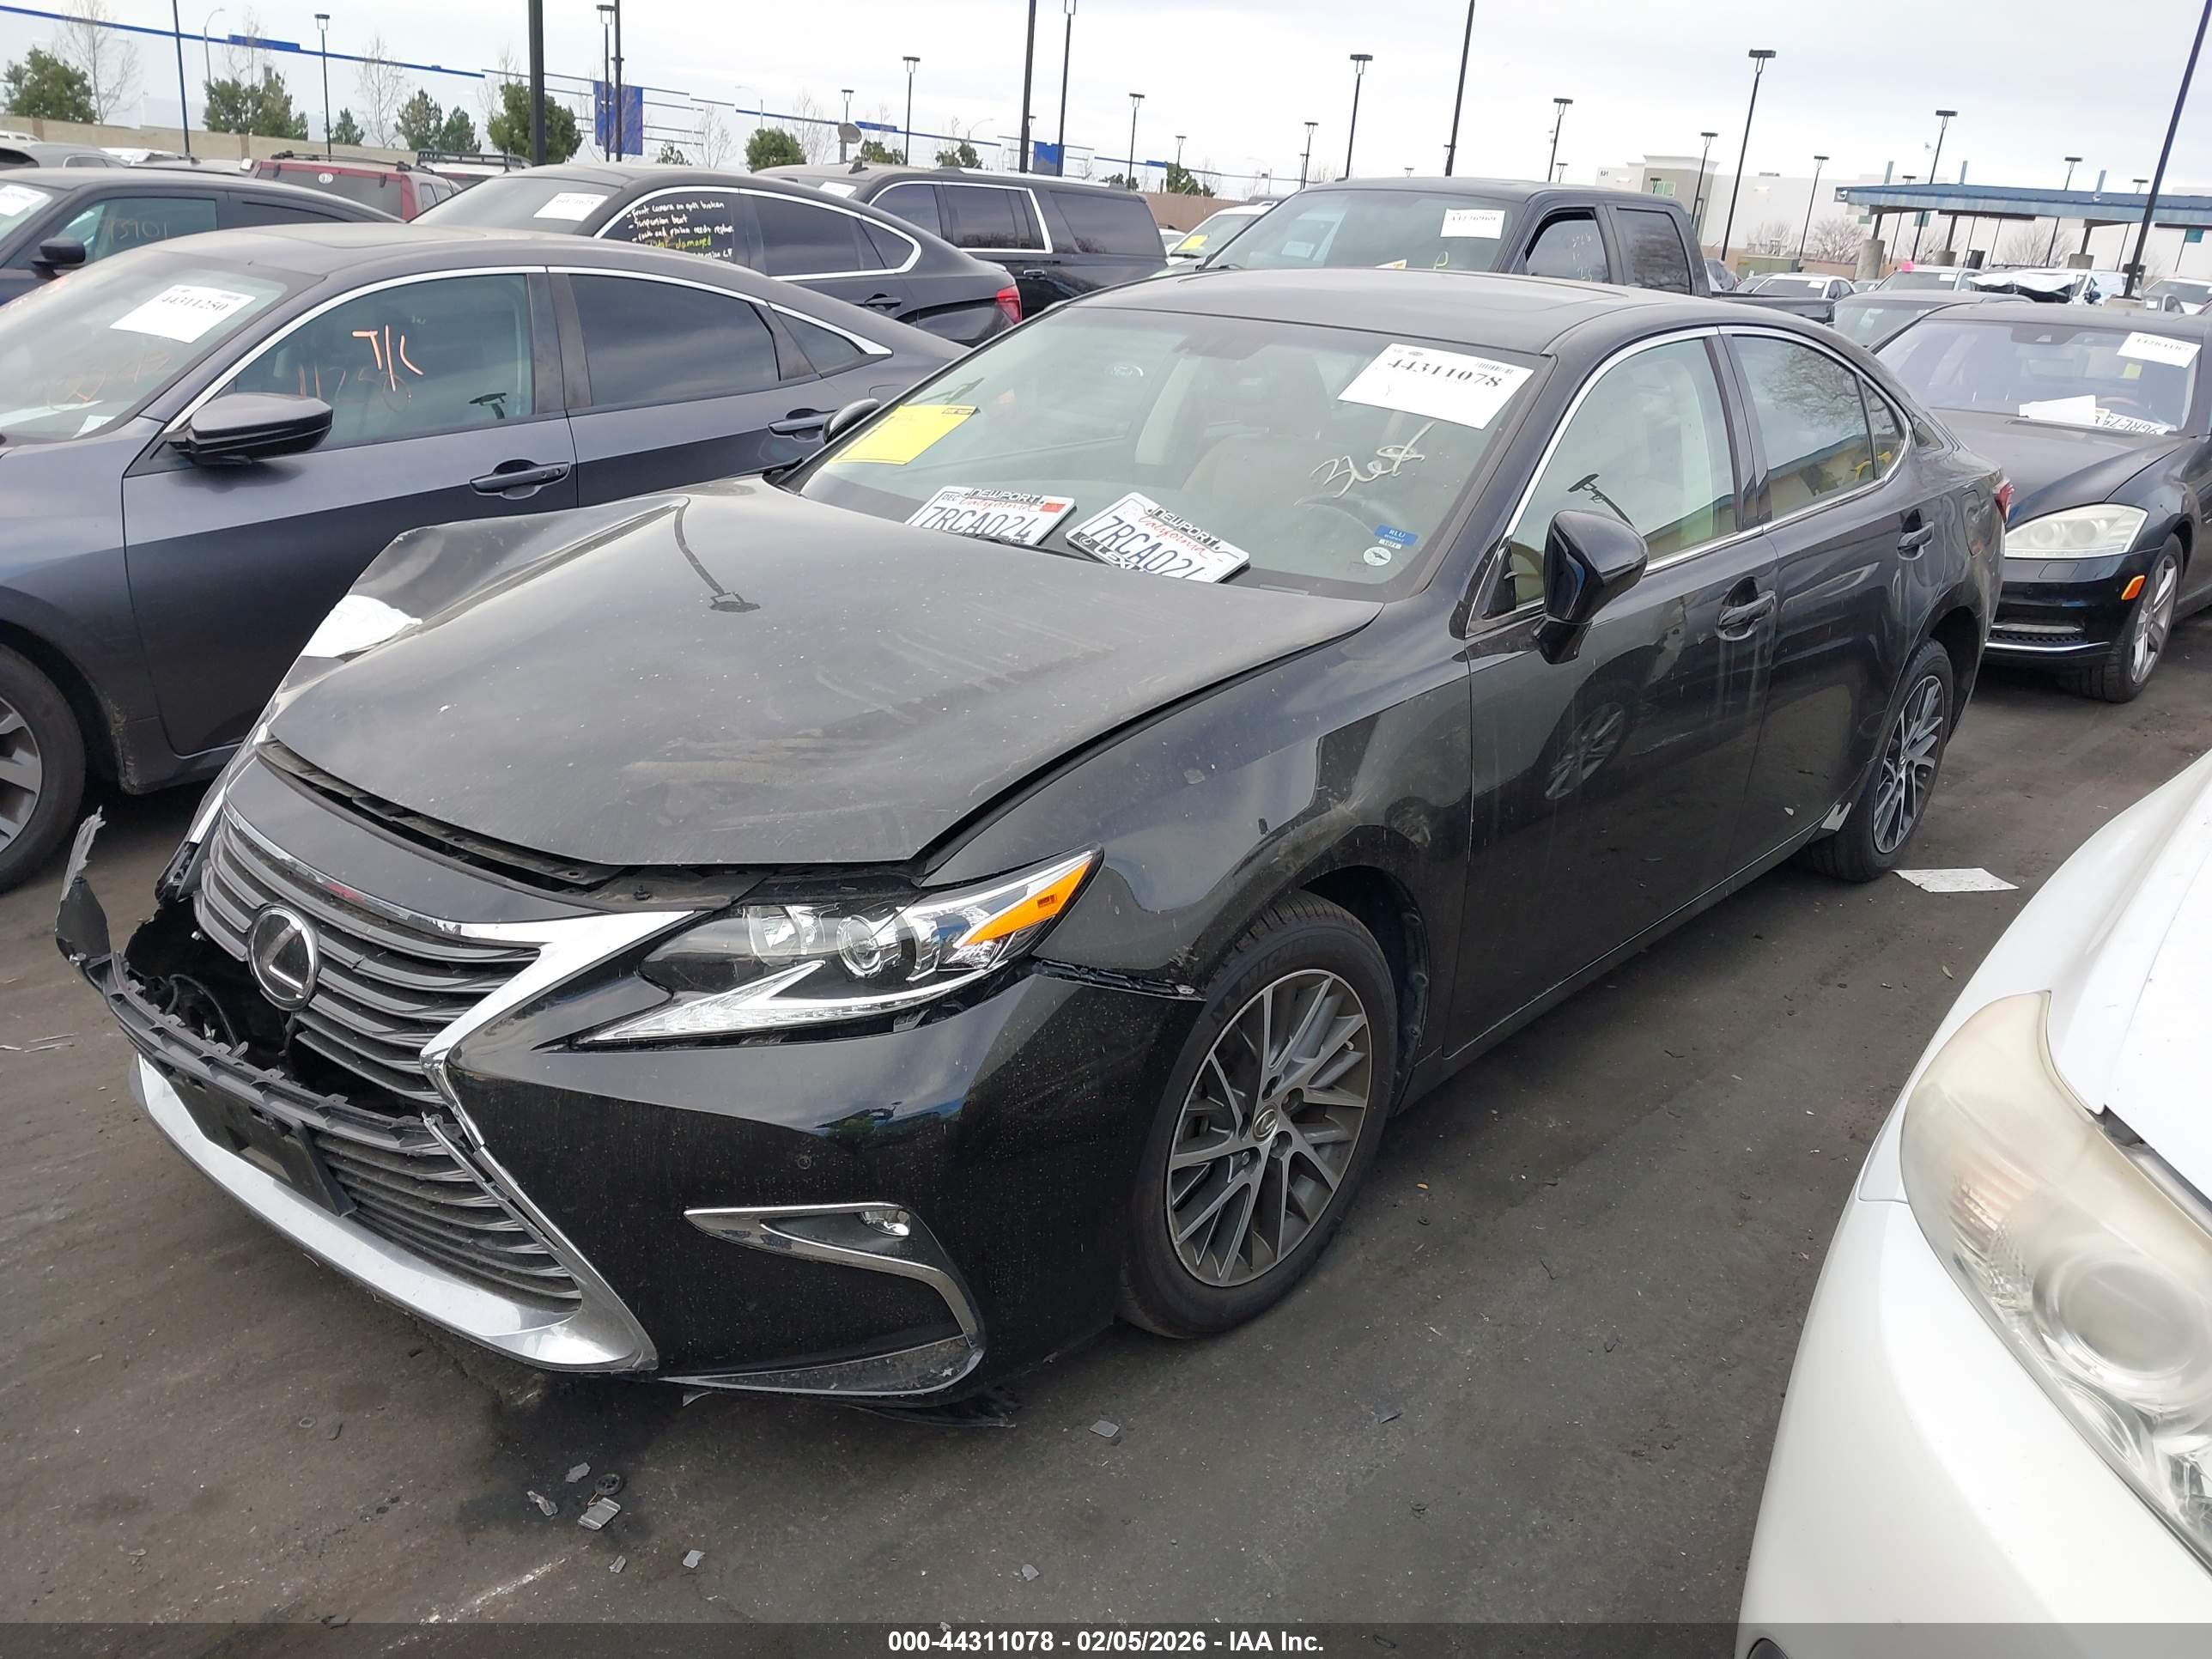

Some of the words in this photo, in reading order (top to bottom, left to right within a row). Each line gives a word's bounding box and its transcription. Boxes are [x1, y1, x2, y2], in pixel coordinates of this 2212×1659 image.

[1387, 358, 1504, 387] 44311078
[969, 488, 1042, 505] NEWPORT
[920, 506, 1040, 542] 7RCA024
[1152, 506, 1219, 547] NEWPORT
